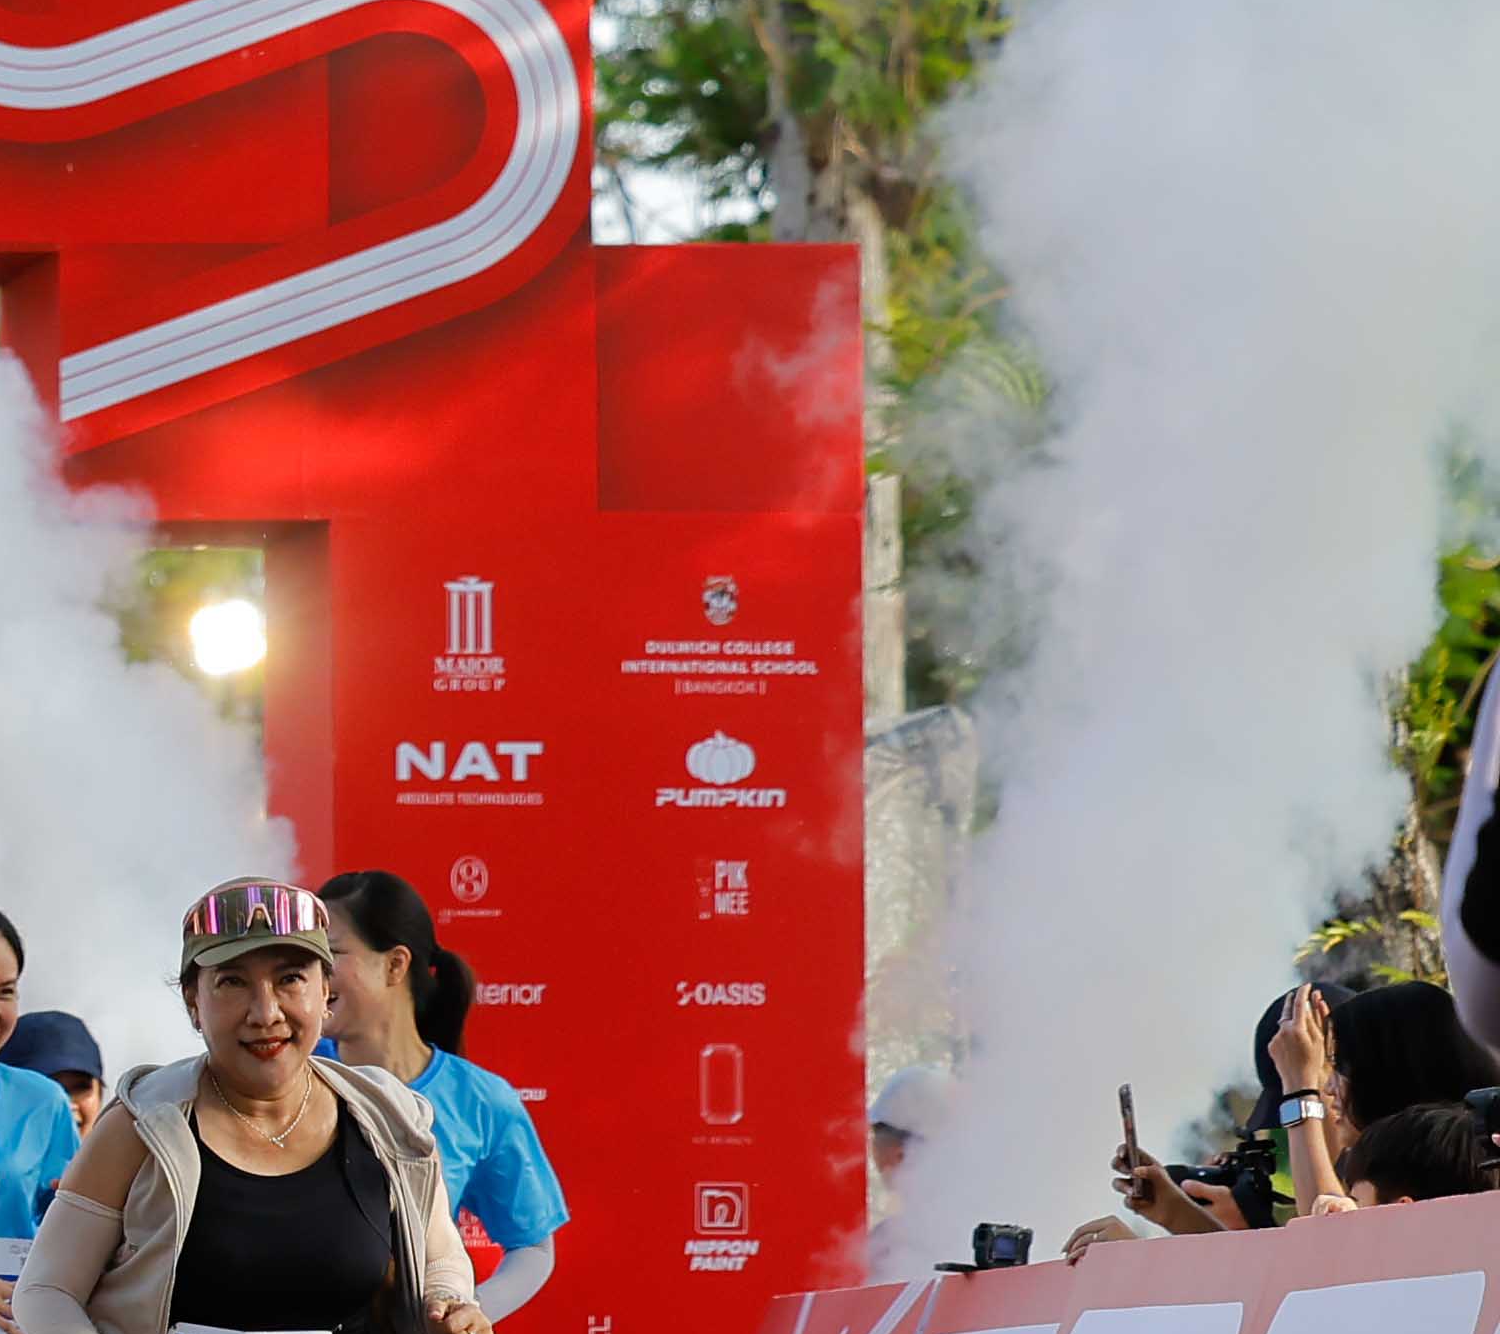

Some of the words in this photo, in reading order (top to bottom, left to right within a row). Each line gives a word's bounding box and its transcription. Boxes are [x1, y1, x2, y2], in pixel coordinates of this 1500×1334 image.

[723, 641, 794, 655] COLLEGE
[621, 660, 747, 675] INTERNATIONAL
[751, 661, 818, 675] SCHOOL
[395, 741, 544, 782] NAT
[655, 788, 787, 808] PUMPKIN
[685, 1240, 760, 1256] NIPPON
[690, 1256, 747, 1272] PAINT
